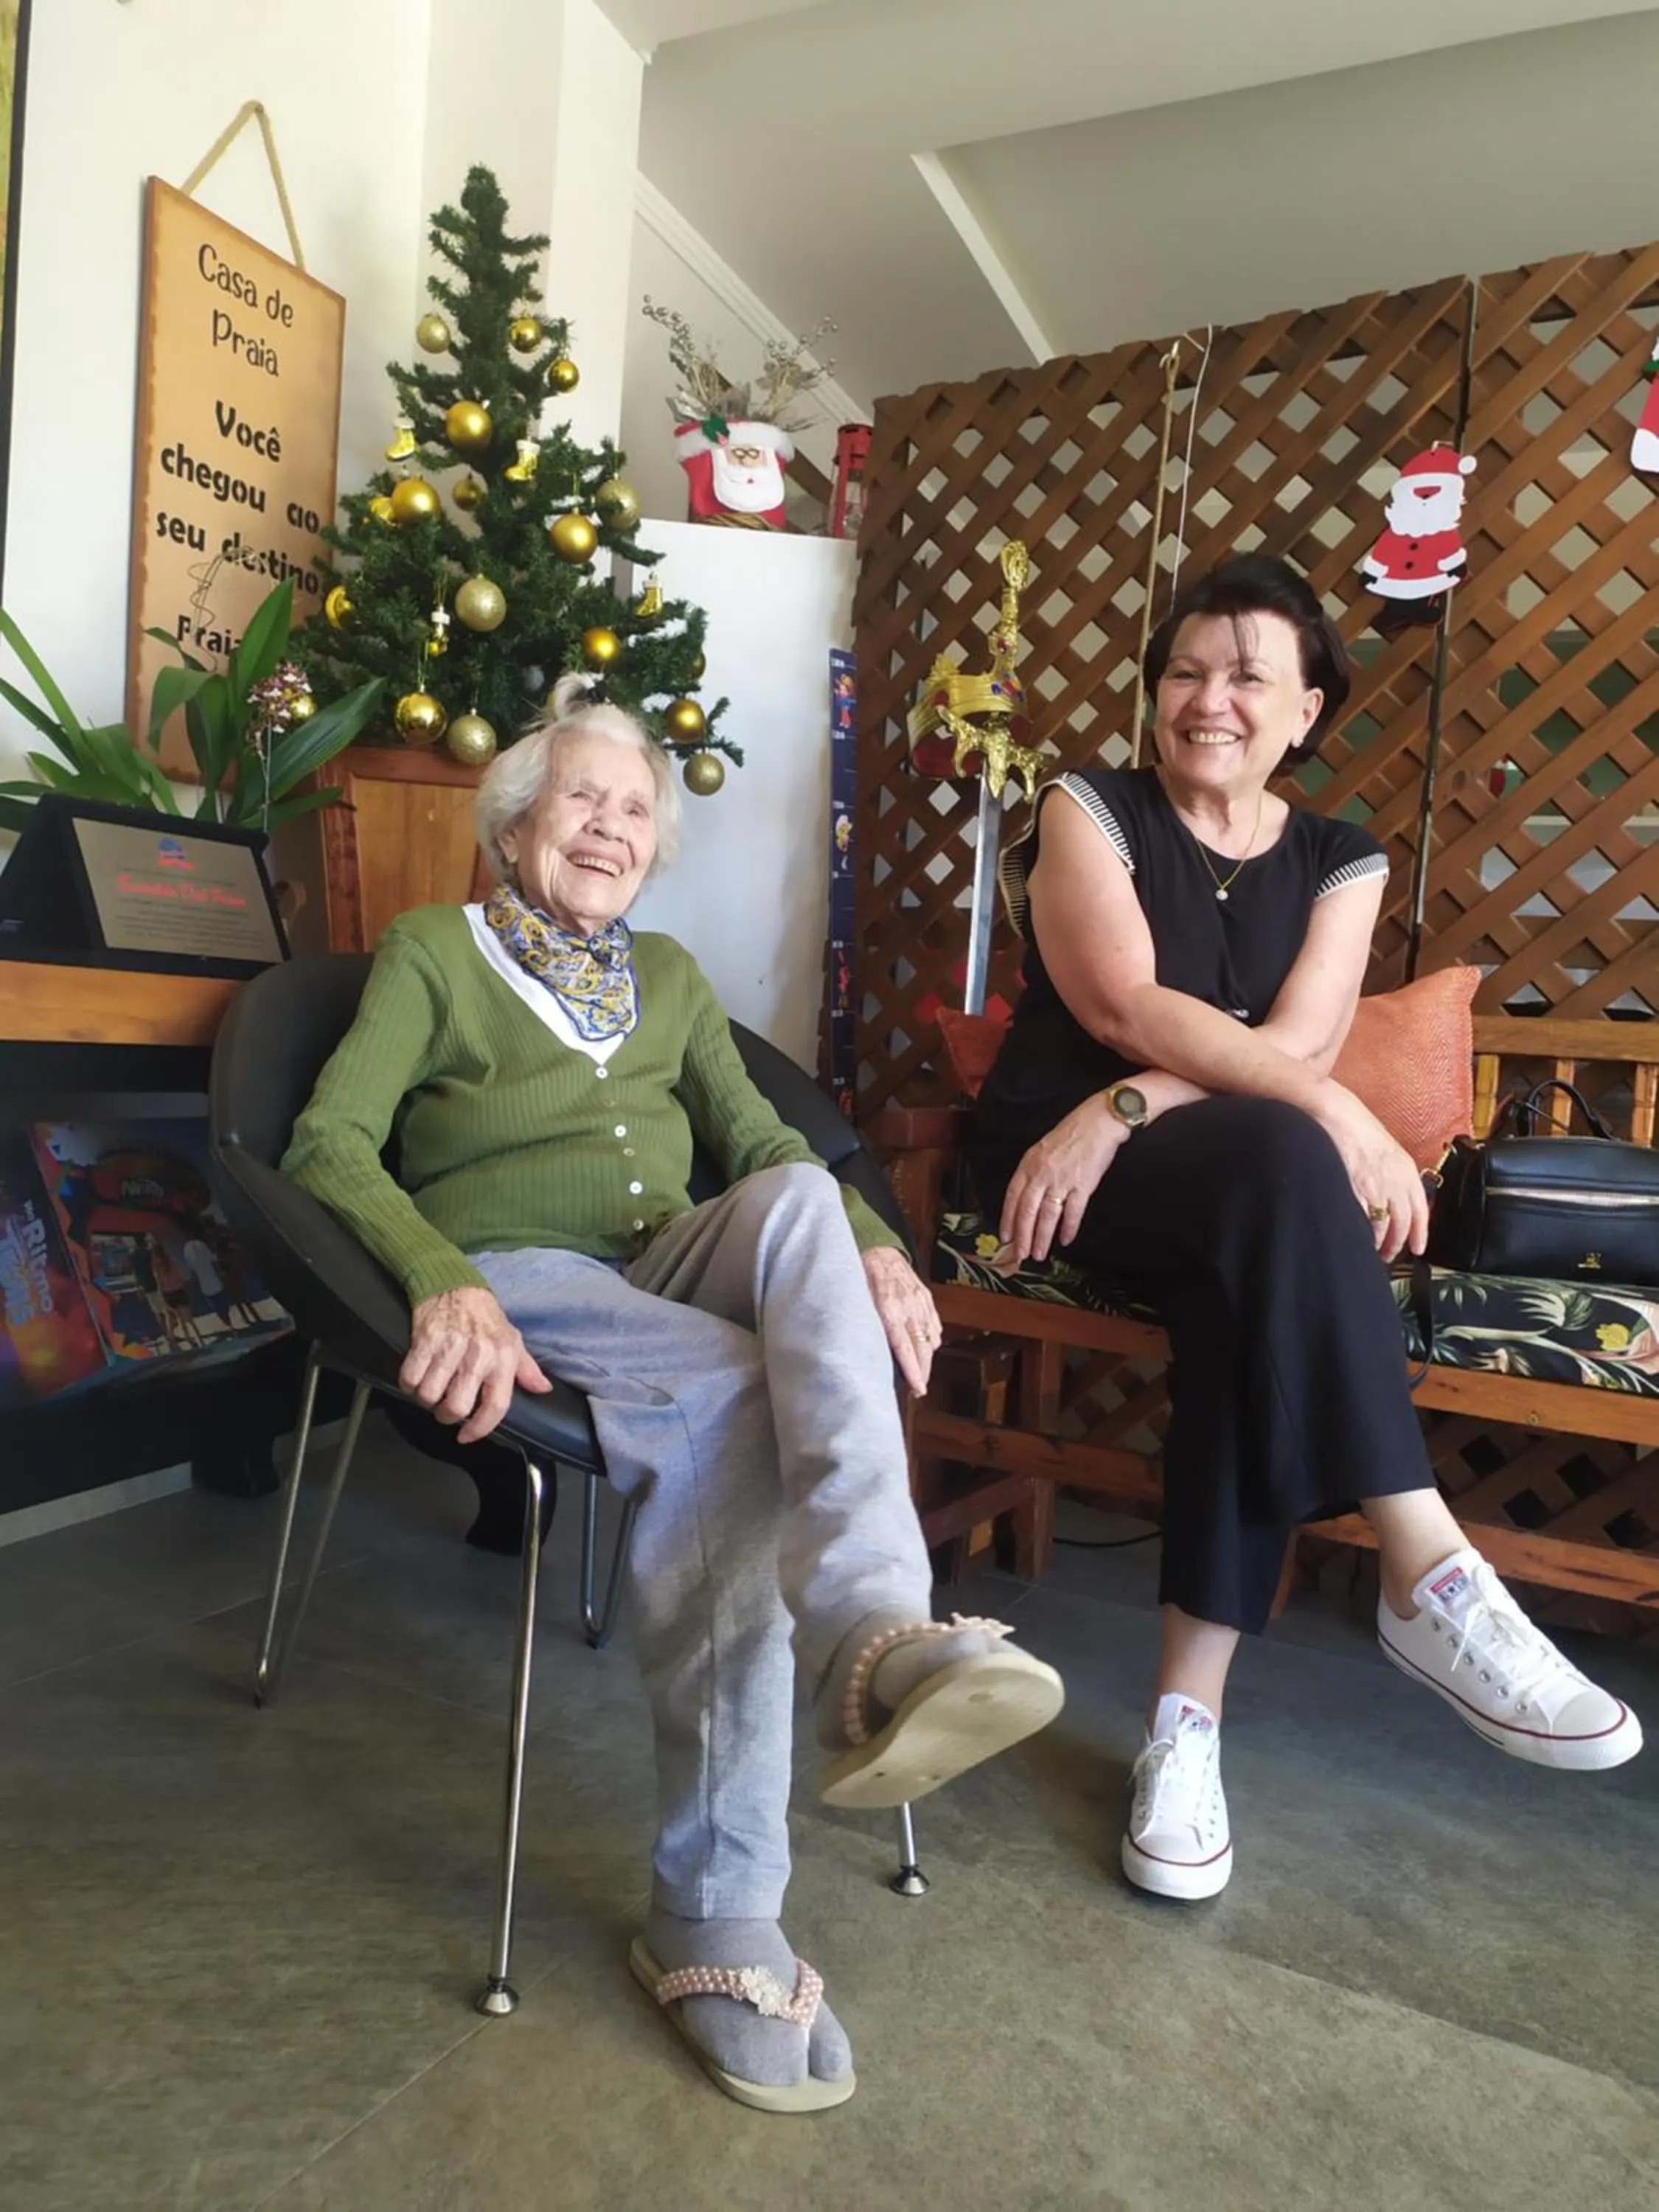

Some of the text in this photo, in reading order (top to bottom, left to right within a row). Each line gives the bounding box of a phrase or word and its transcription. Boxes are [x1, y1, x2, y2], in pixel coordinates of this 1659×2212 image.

[198, 243, 293, 328] Casa de
[212, 308, 279, 377] Praia
[215, 400, 281, 462] Você
[161, 442, 319, 534] chegou ao
[156, 512, 319, 594] seu destino
[178, 615, 241, 655] Prai
